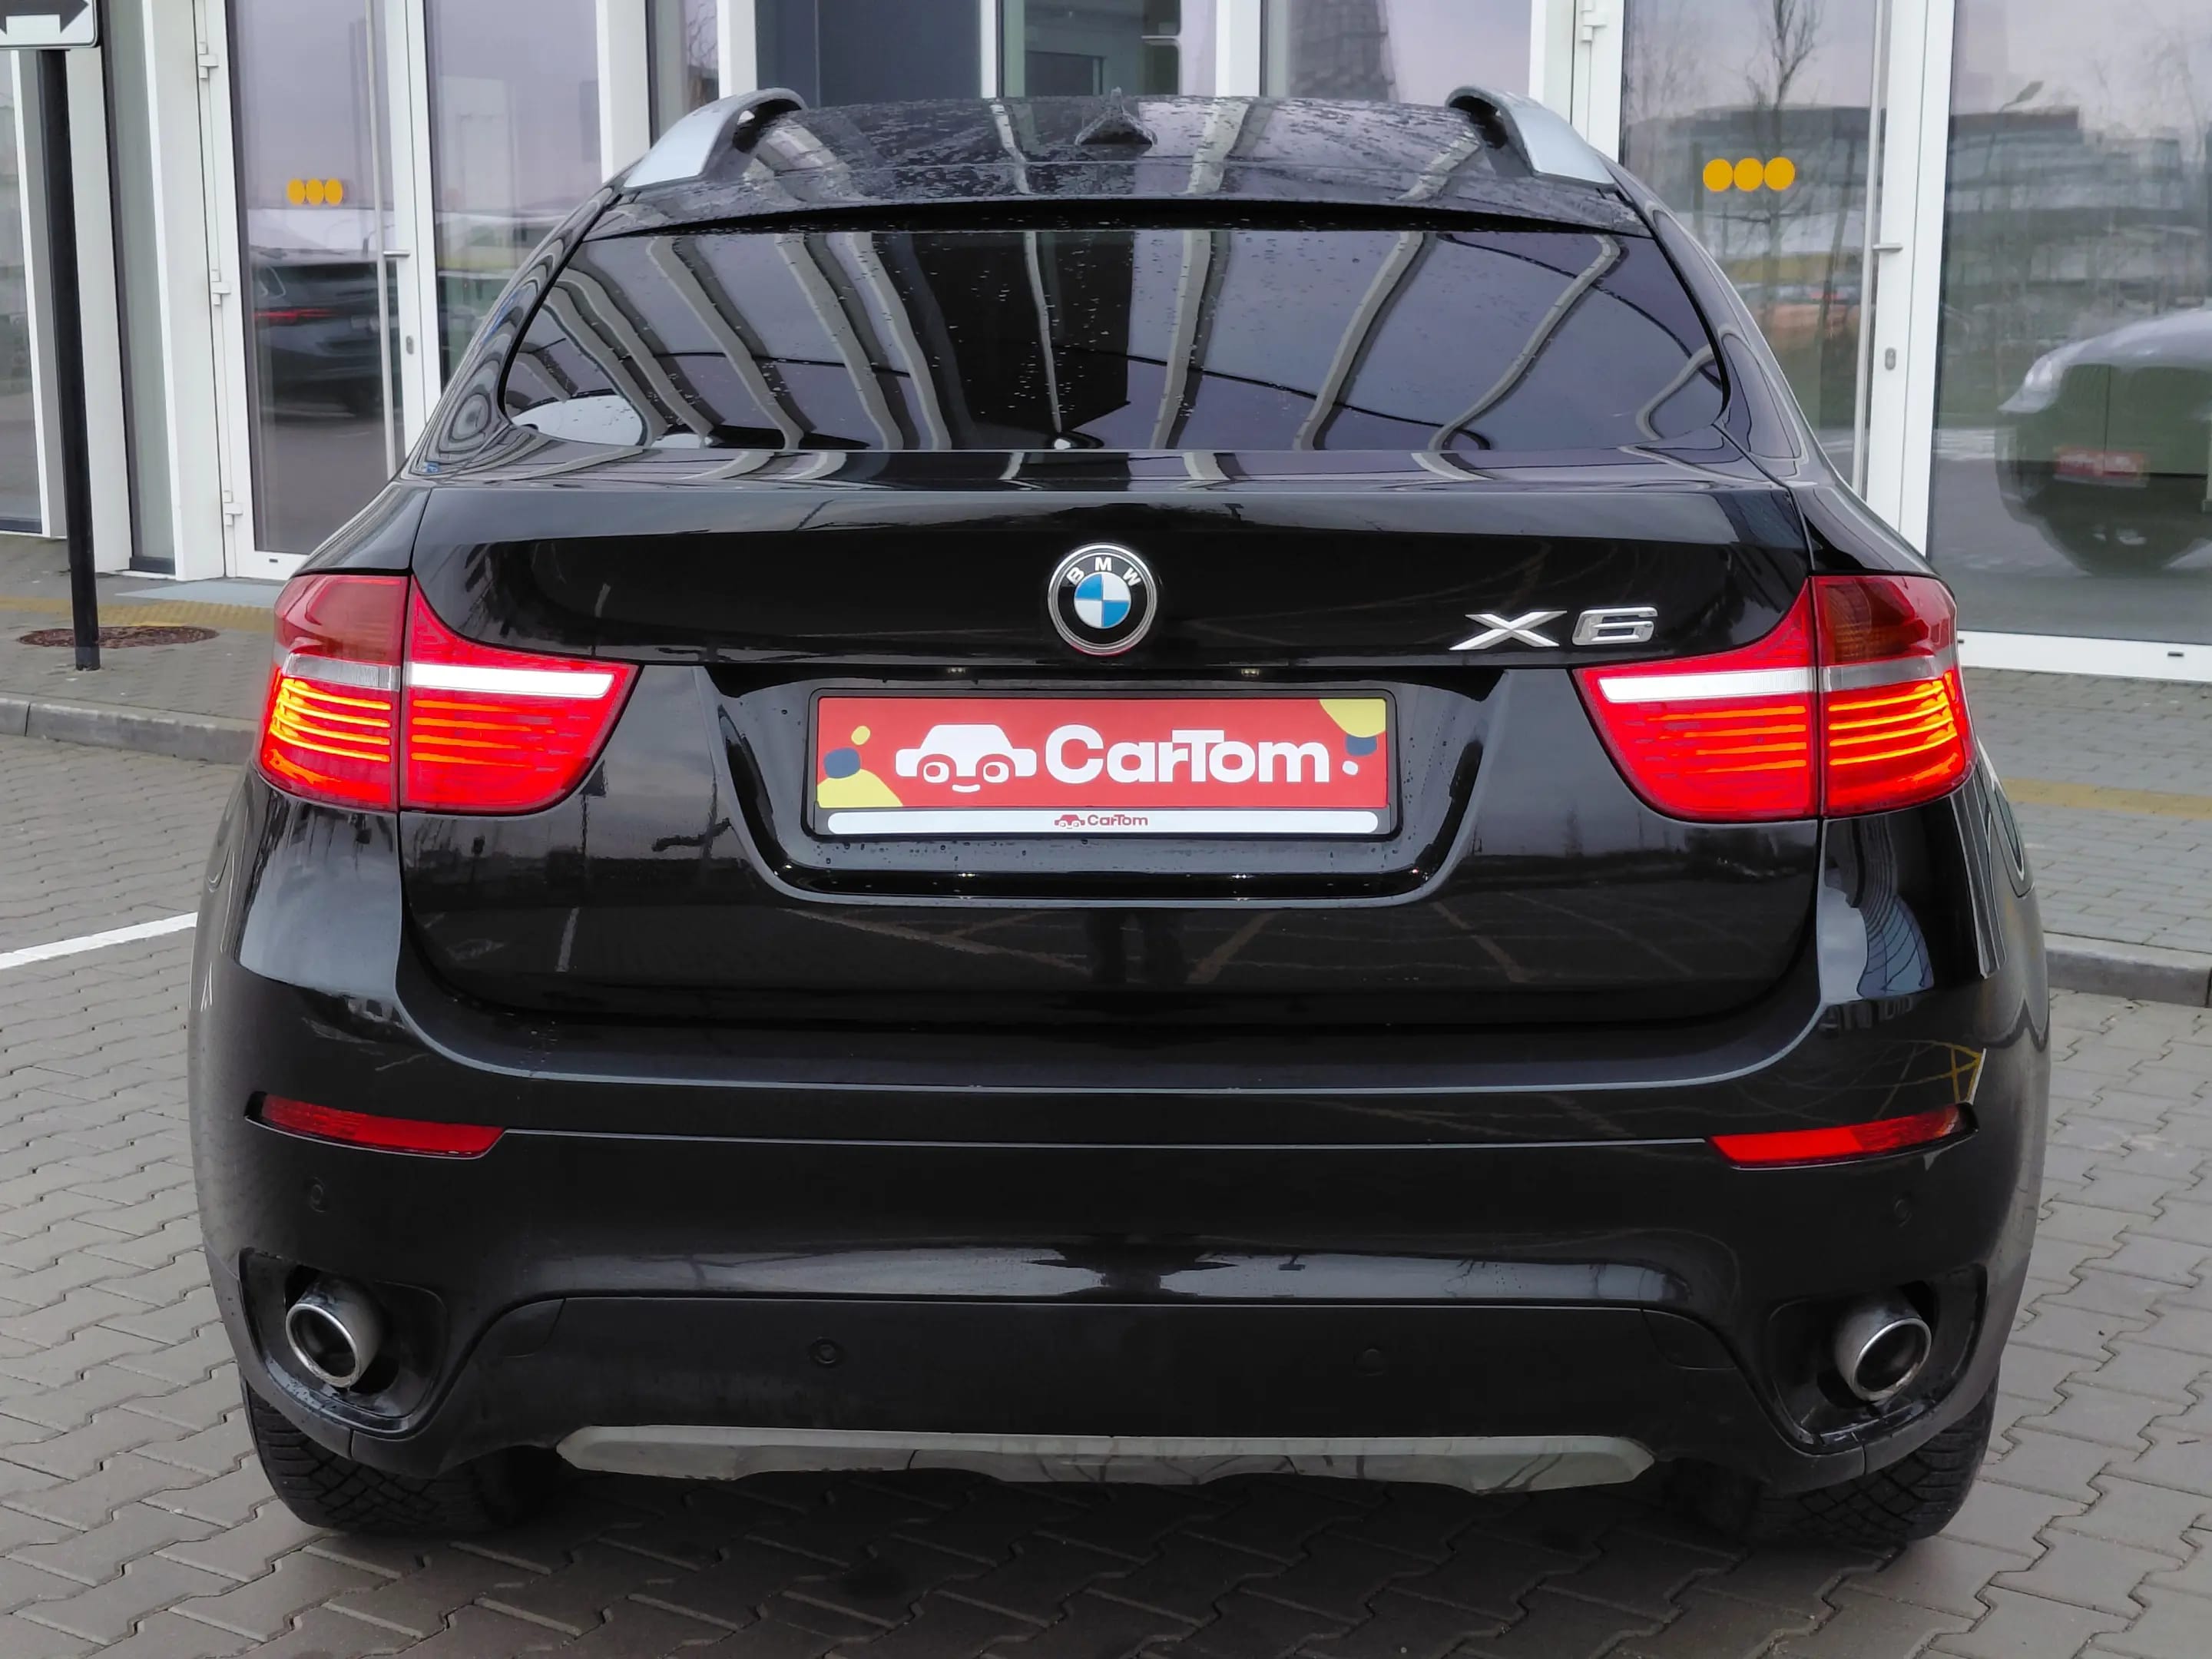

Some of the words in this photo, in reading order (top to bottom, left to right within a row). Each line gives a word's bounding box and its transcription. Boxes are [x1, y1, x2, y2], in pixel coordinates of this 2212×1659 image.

[1066, 556, 1141, 587] BMW
[1449, 606, 1658, 651] X6
[1045, 724, 1330, 783] CarTom
[1087, 814, 1148, 826] CarTom
